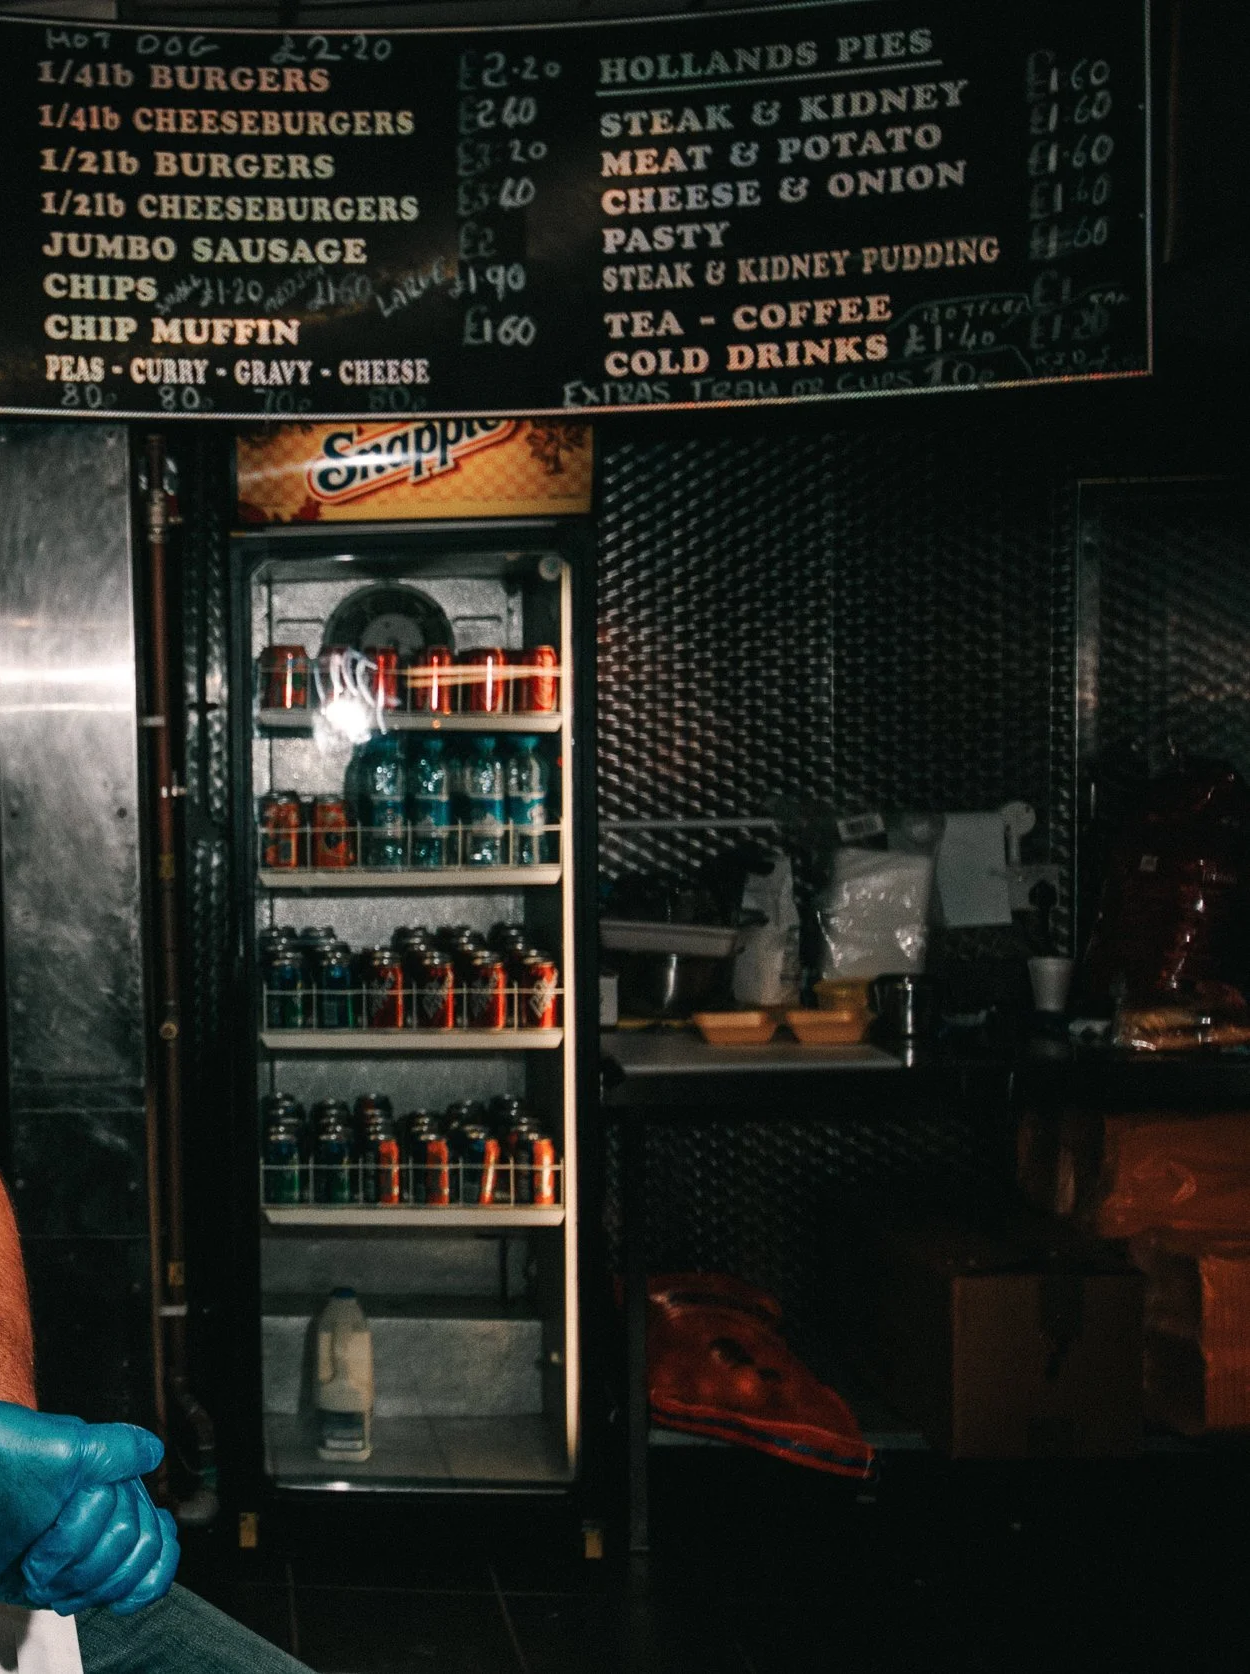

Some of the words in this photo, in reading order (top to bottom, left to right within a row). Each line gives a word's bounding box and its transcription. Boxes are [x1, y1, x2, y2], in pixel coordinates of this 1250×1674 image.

[45, 28, 111, 51] HOT
[599, 40, 819, 85] HOLLANDS
[836, 27, 933, 64] PIES
[37, 59, 135, 88] 1/4lb
[149, 64, 331, 93] BURGERS
[38, 102, 122, 132] 1/4lb
[132, 106, 416, 137] CHEESEBURGERS
[599, 103, 734, 138] STEAK
[751, 99, 782, 127] &
[798, 79, 969, 123] KIDNEY
[38, 146, 141, 176] 1/2lb
[153, 150, 335, 180] BURGERS
[600, 144, 712, 178] MEAT
[729, 141, 760, 168] &
[777, 122, 942, 163] POTATO
[601, 178, 762, 216] CHEESE
[778, 175, 810, 203] &
[827, 159, 968, 198] ONION
[40, 188, 127, 218] 1/2lb
[137, 193, 420, 222] CHEESEBURGERS
[41, 232, 177, 262] JUMBO
[191, 236, 368, 264] SAUSAGE
[602, 221, 730, 255] PASTY
[602, 262, 695, 293] STEAK
[705, 260, 726, 286] &
[737, 249, 851, 284] KIDNEY
[861, 235, 1000, 275] PUDDING
[42, 272, 159, 302] CHIPS
[43, 313, 139, 342] CHIP
[150, 316, 302, 346] MUFFIN
[604, 309, 685, 339] TEA
[732, 294, 893, 332] COFFEE
[45, 354, 105, 382] PEAS
[130, 356, 209, 385] CURRY
[234, 359, 313, 386] GRAVY
[338, 359, 430, 386] CHEESE
[604, 345, 710, 378] COLD
[725, 333, 889, 373] DRINKS
